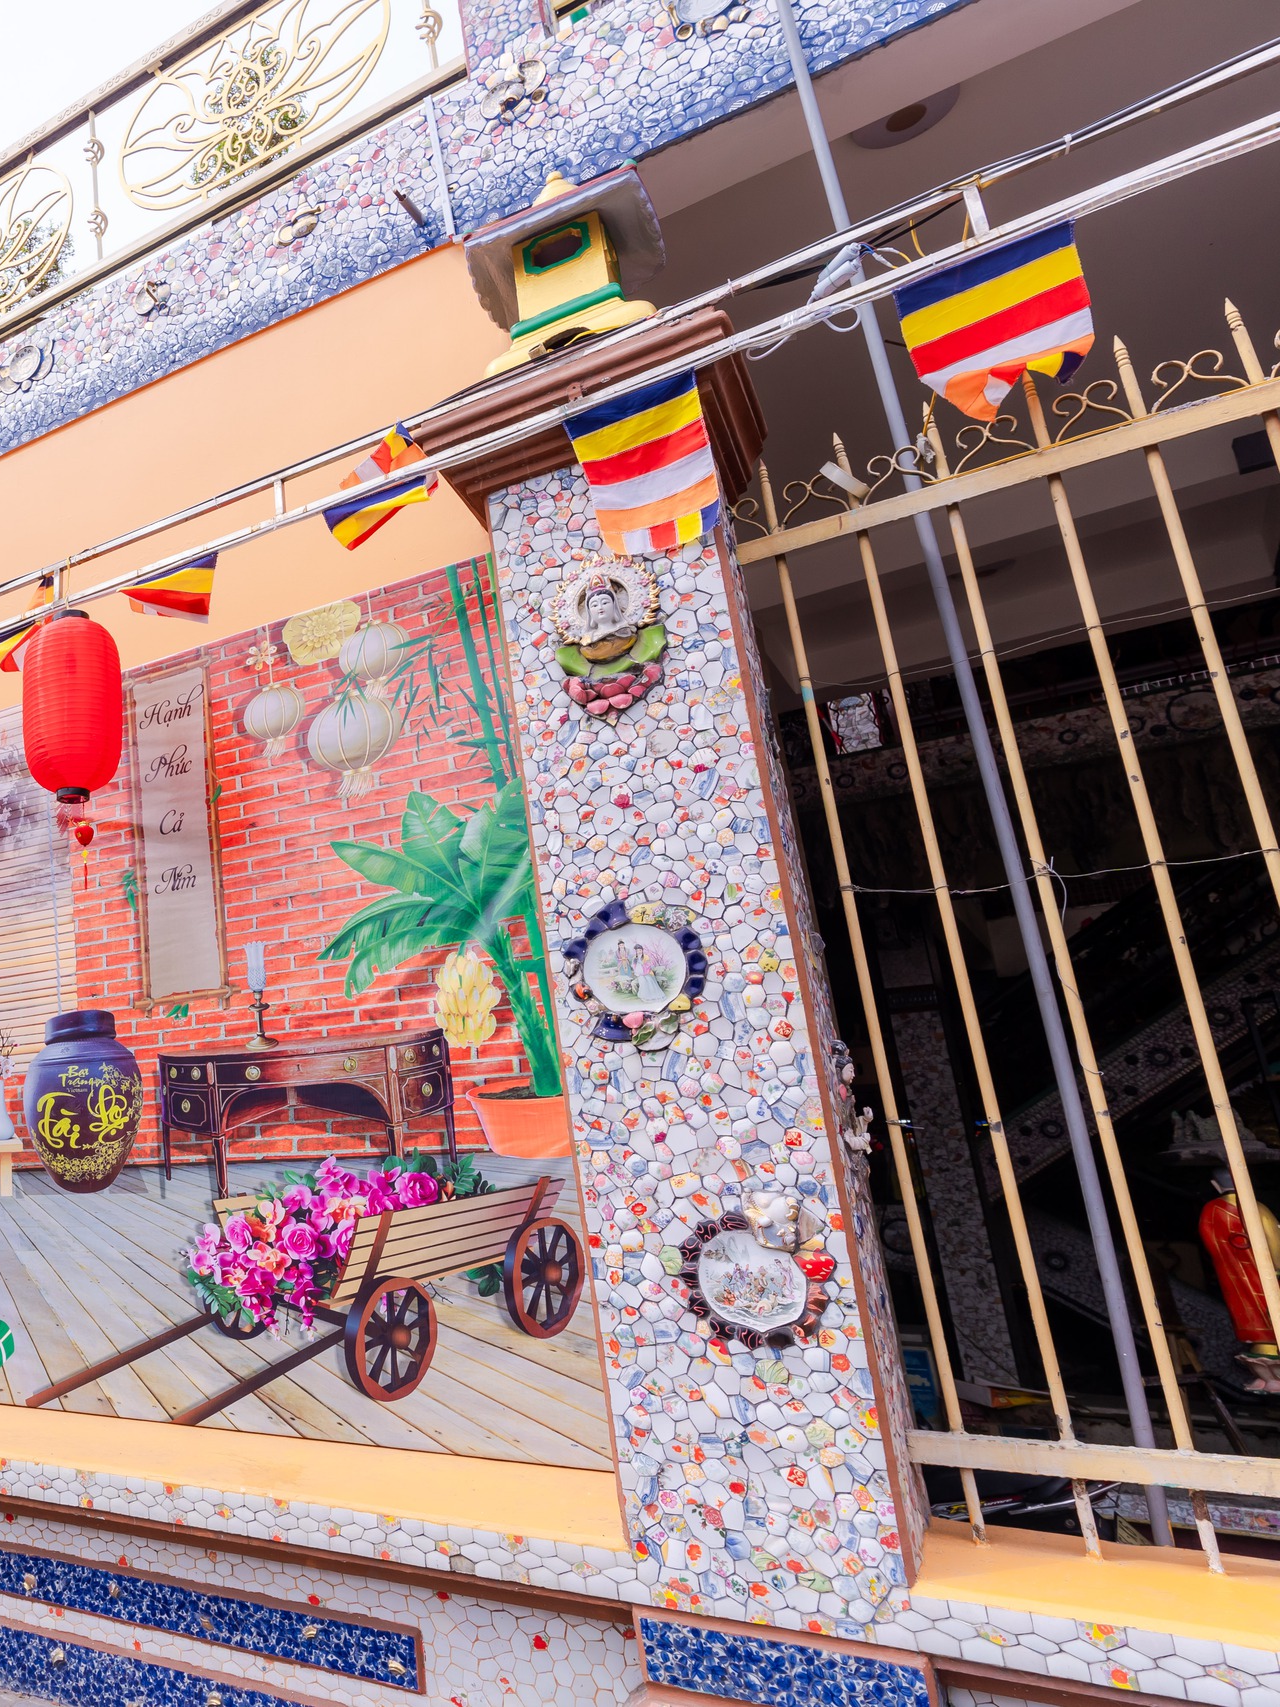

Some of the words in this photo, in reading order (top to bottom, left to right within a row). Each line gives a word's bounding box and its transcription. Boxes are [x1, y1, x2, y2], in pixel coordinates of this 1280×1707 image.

[139, 683, 204, 730] Hạnh
[144, 744, 193, 783] Phúc
[159, 809, 185, 836] Cả
[36, 1091, 82, 1149] Tài
